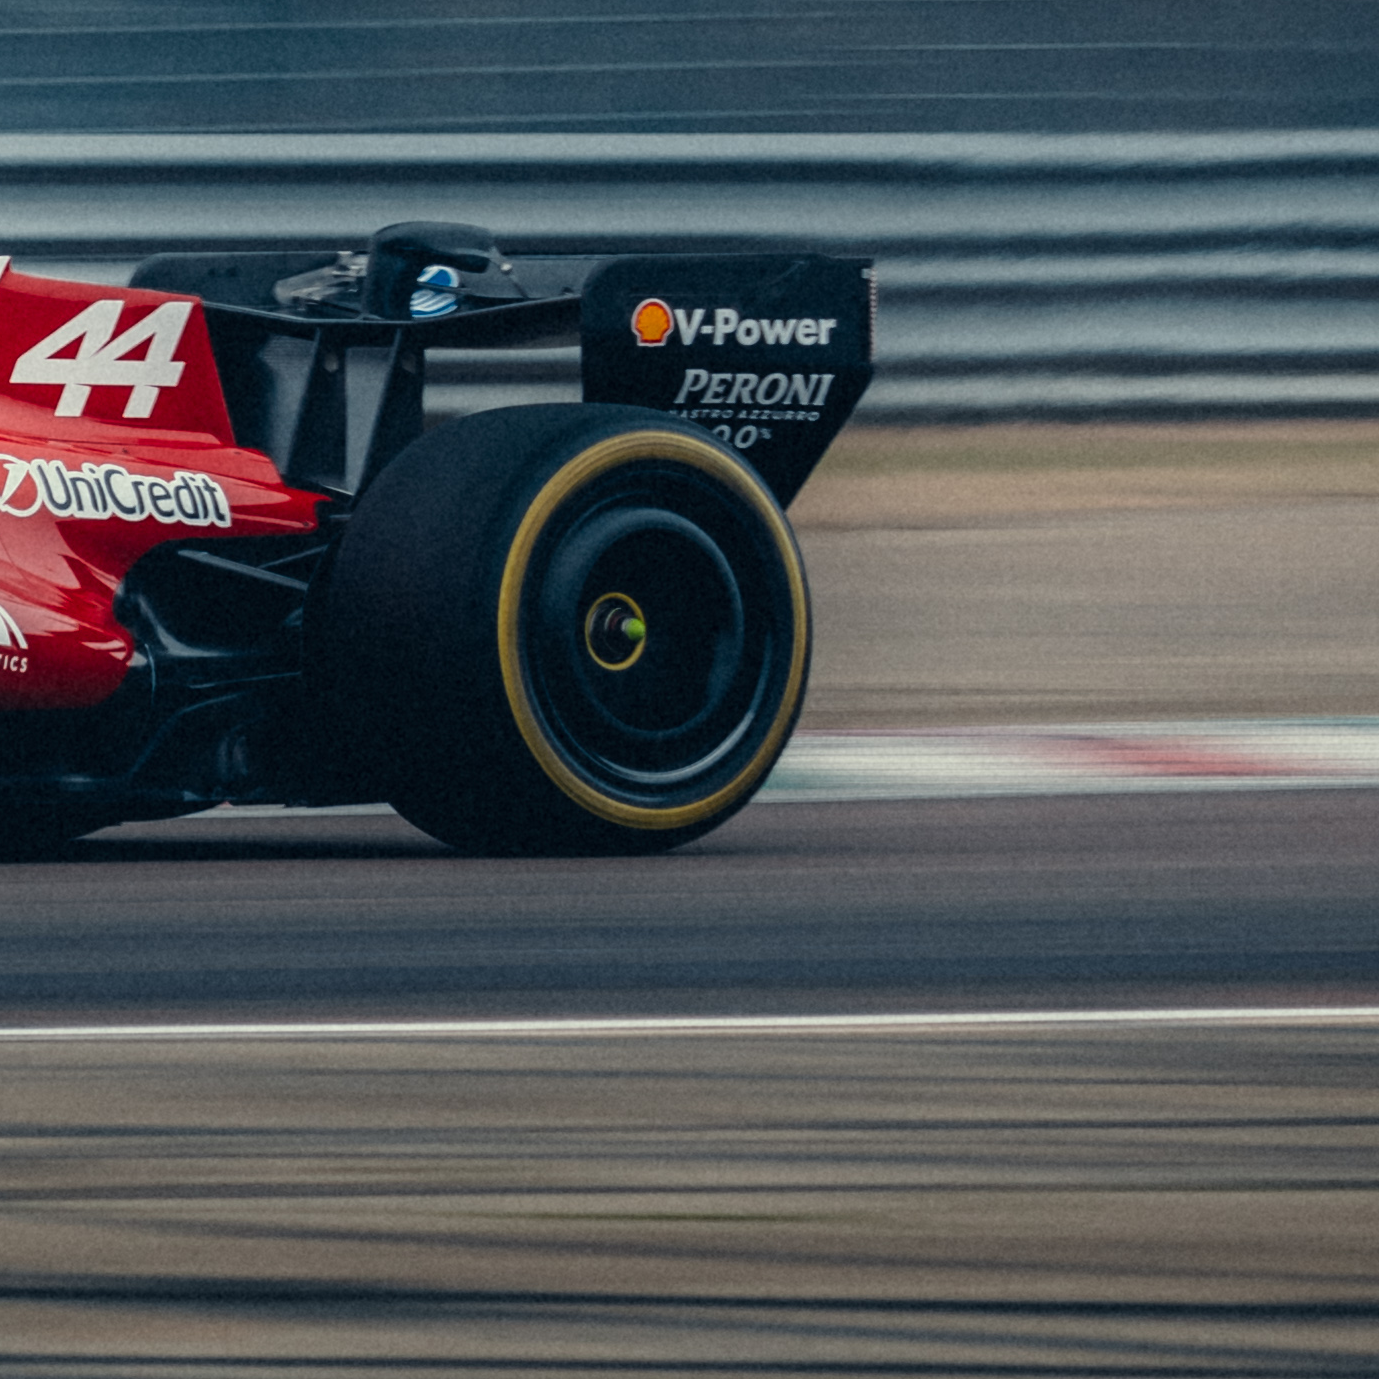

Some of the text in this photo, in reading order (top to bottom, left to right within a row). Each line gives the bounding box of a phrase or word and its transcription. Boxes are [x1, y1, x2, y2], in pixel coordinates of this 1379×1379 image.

[673, 308, 838, 346] V-Power
[9, 299, 194, 419] 44
[673, 368, 835, 407] PERONI
[37, 463, 227, 523] UniCredit
